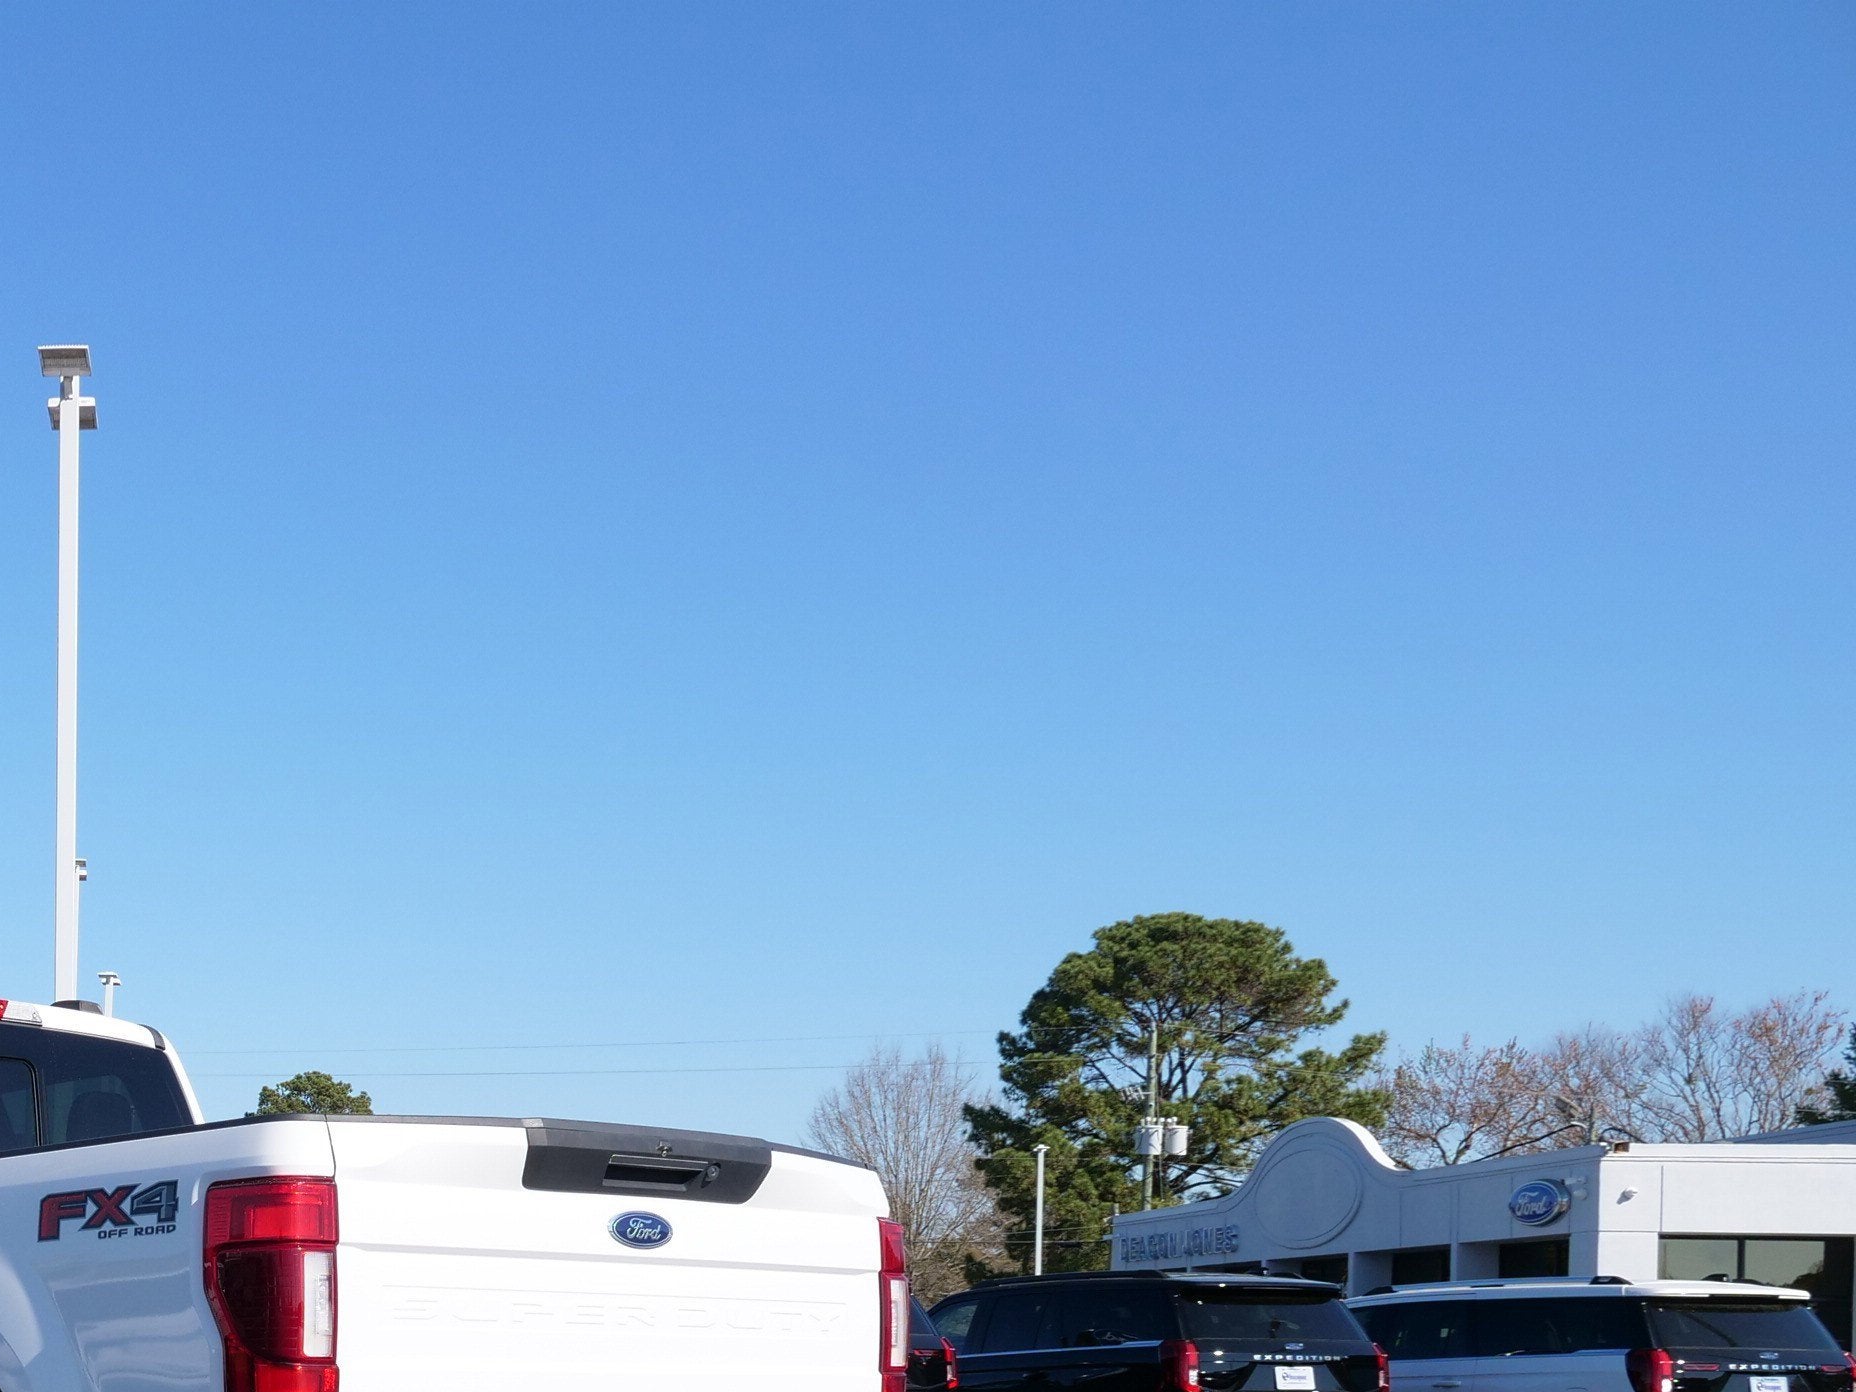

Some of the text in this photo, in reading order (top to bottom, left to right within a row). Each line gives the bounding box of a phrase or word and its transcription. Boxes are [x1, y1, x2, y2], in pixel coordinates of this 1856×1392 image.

[37, 1179, 180, 1243] FX4
[1515, 1191, 1549, 1216] Ford
[97, 1224, 177, 1240] OFF ROAD
[626, 1217, 662, 1241] Ford
[1183, 1224, 1240, 1257] JONES
[1728, 1363, 1817, 1371] EXPEDITION
